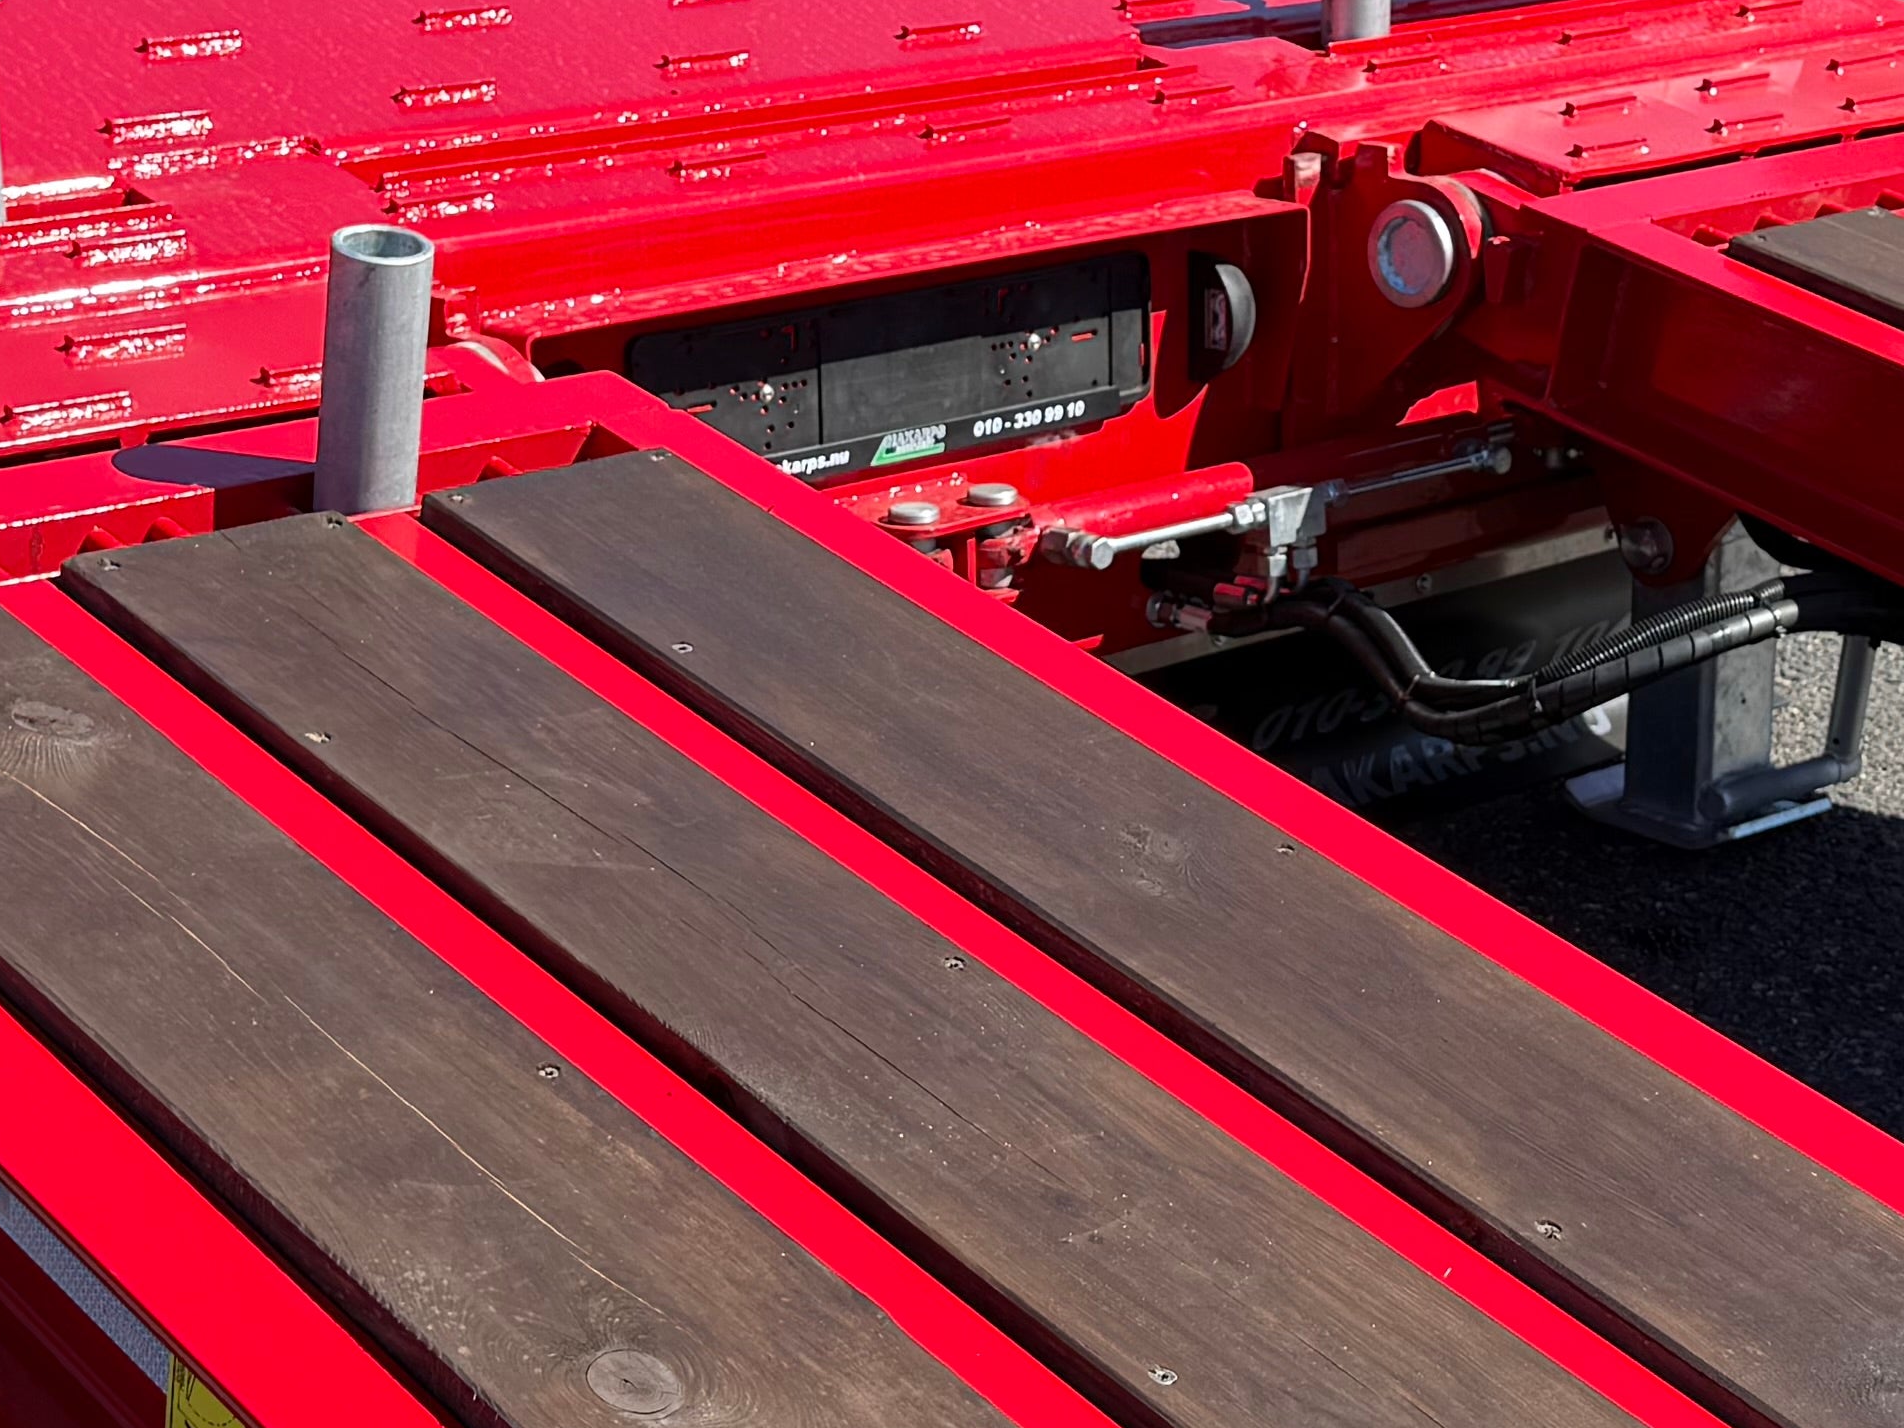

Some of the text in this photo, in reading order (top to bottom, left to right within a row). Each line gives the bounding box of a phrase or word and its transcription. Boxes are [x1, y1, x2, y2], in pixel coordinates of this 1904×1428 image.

[973, 417, 1003, 437] 010
[1013, 409, 1042, 429] 330
[1044, 405, 1064, 423] 99
[1067, 400, 1085, 418] 10
